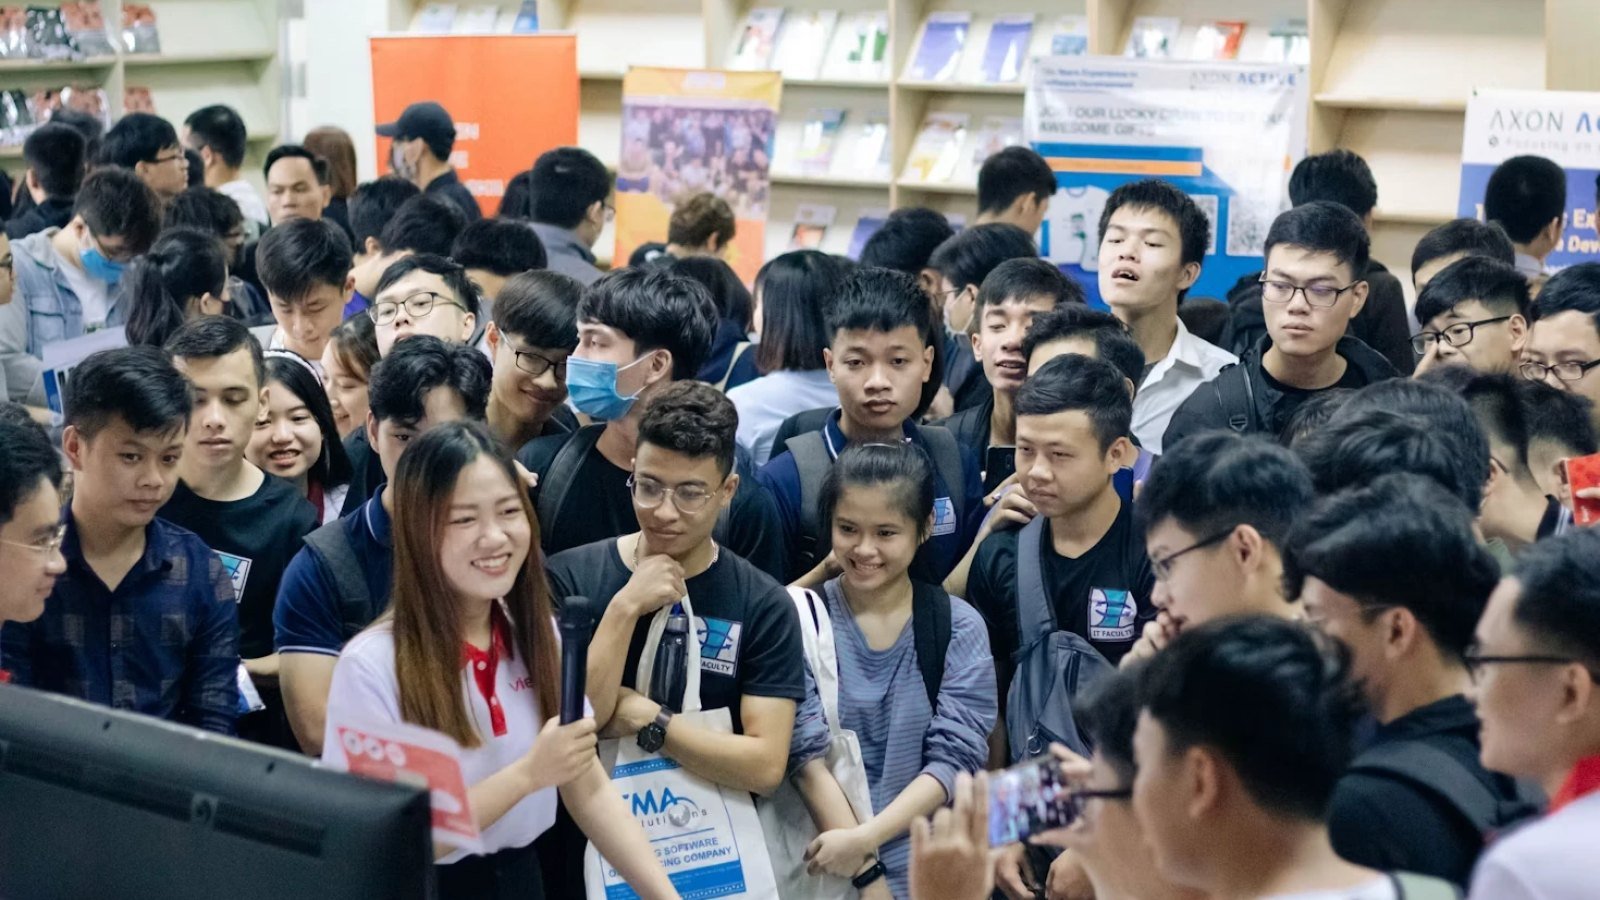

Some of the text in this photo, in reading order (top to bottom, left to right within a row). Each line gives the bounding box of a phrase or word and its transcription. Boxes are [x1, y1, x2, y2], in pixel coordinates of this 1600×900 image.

[1075, 107, 1106, 119] OUR
[1108, 108, 1158, 120] LUCKY
[1489, 109, 1600, 133] AXON A
[701, 660, 730, 672] ACULTY
[622, 787, 678, 817] MA
[664, 837, 718, 856] SOFTWARE
[683, 847, 731, 864] COMPANY
